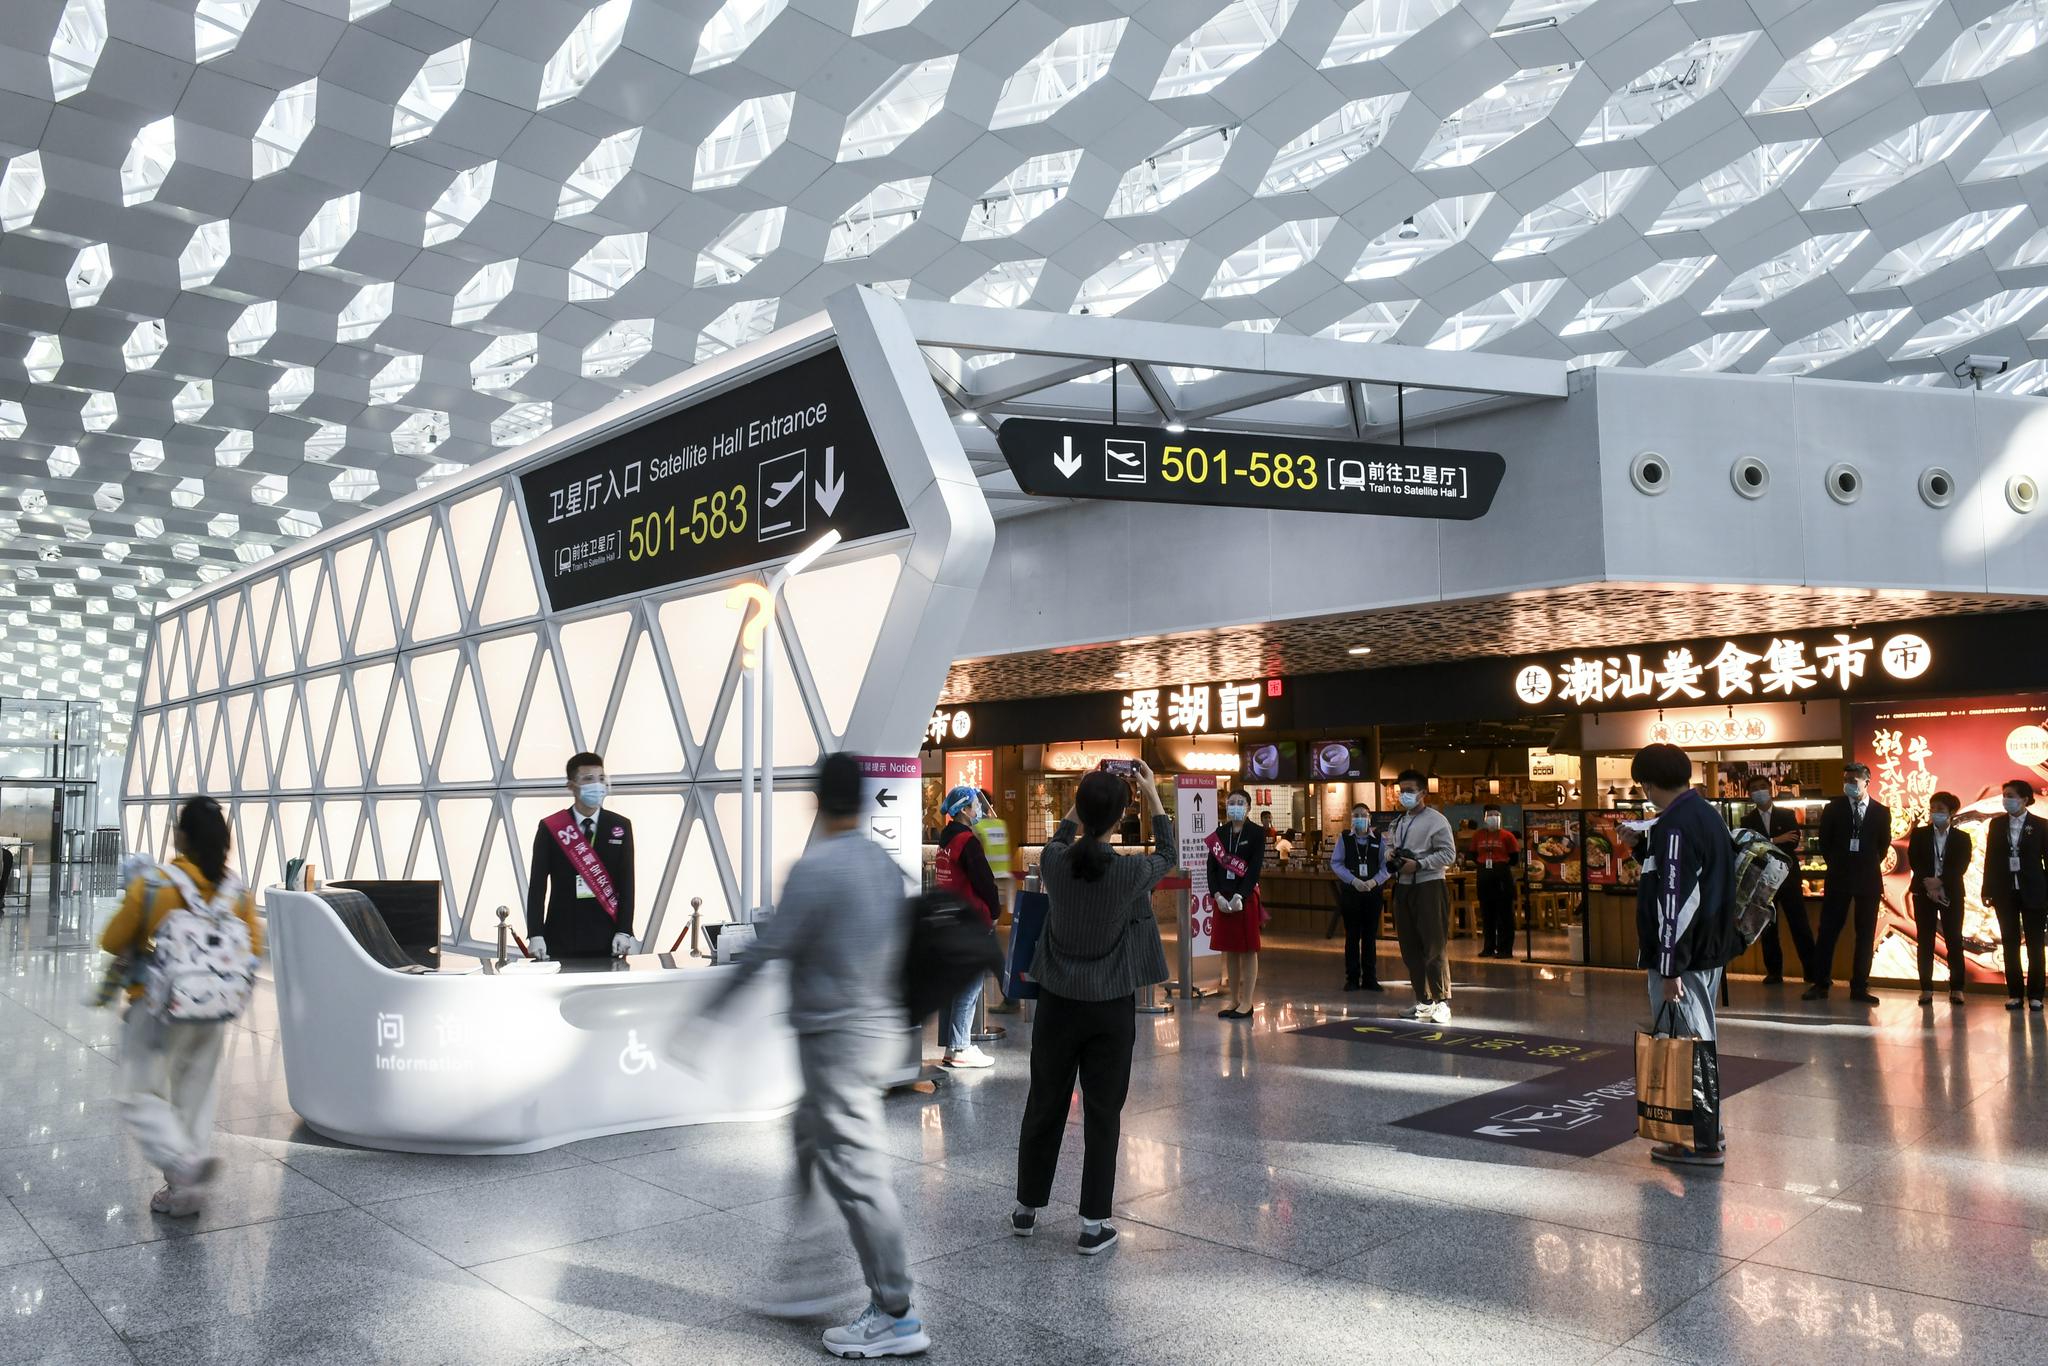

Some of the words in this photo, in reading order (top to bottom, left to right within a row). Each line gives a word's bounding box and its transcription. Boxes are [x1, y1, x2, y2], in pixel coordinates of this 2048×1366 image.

[547, 460, 642, 524] 卫星厅入口
[649, 444, 707, 482] Satellite
[712, 427, 743, 461] Hall
[748, 402, 828, 448] Entrance
[1161, 446, 1318, 490] 501-583
[1368, 461, 1456, 486] 前往卫星厅
[1369, 482, 1391, 494] Train
[1393, 484, 1401, 494] to
[1403, 485, 1439, 497] Satellite
[1440, 487, 1457, 498] Hall
[628, 484, 748, 562] 501-583
[572, 532, 616, 562] 前往卫星厅
[606, 552, 616, 563] Hall
[1557, 634, 1874, 706] 潮汕美食集市
[1121, 682, 1265, 737] 深湖記
[922, 709, 951, 745] 市
[889, 762, 917, 773] Notice
[1907, 735, 1938, 828] 牛腩粿
[376, 1053, 473, 1073] Information
[1552, 1088, 1636, 1113] 14-78
